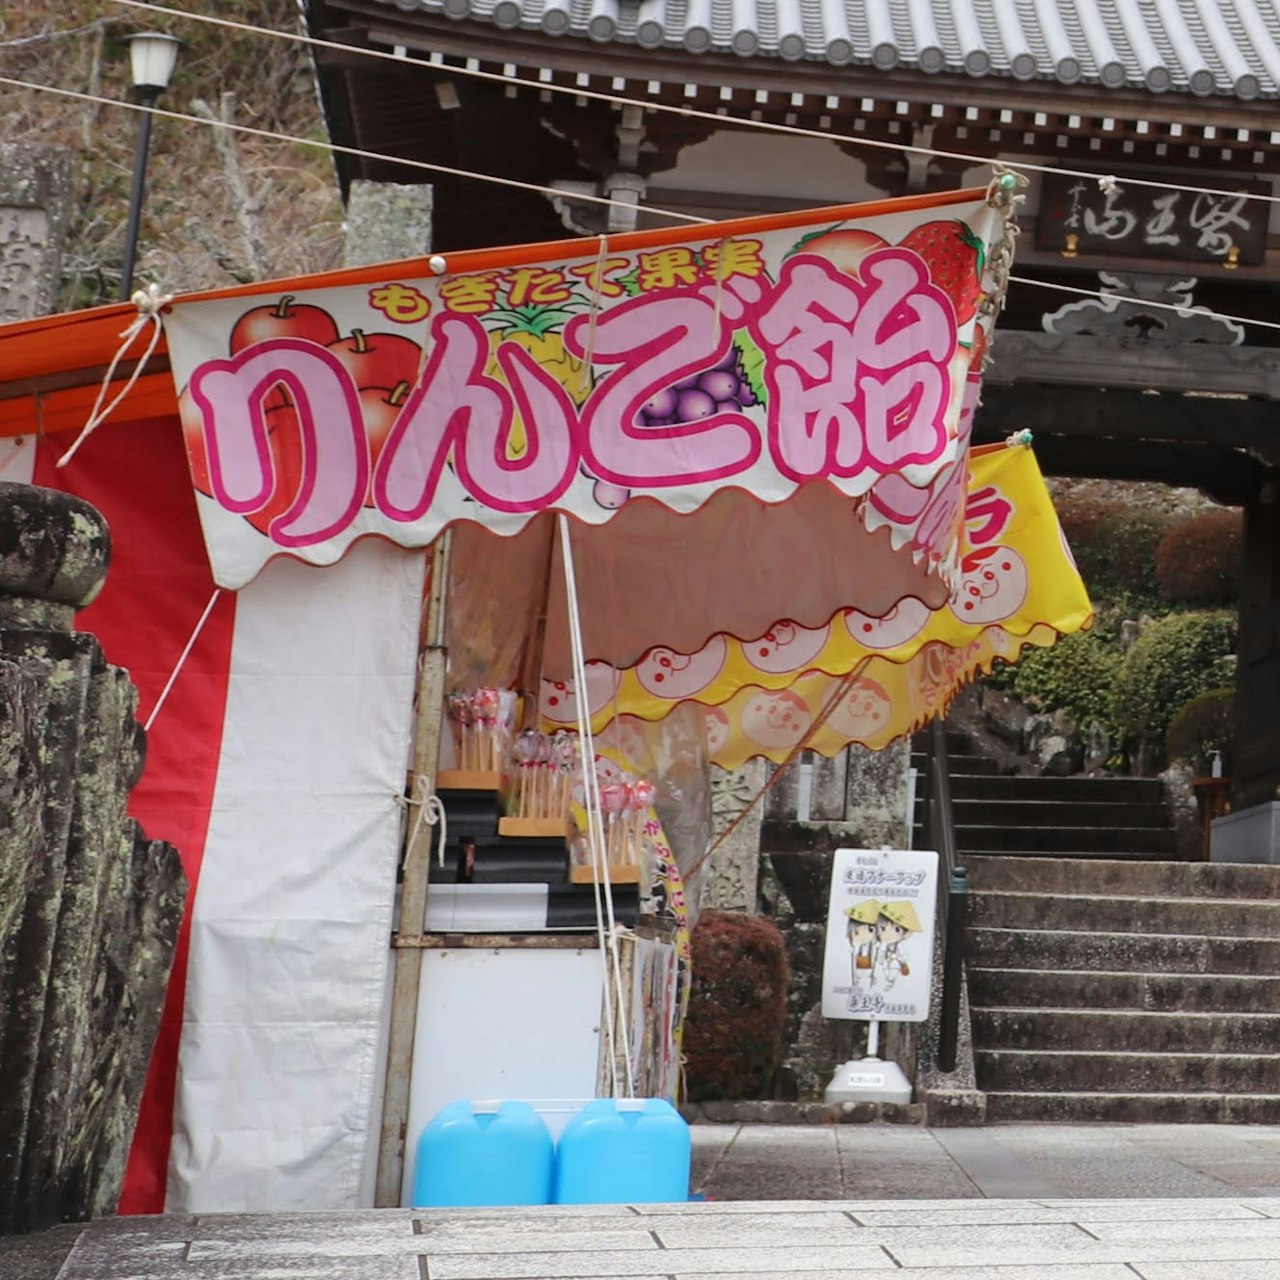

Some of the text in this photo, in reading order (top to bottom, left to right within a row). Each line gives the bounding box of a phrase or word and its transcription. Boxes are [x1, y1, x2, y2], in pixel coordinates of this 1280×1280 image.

[369, 240, 765, 322] もぎたて果実
[190, 247, 958, 548] りんご飴
